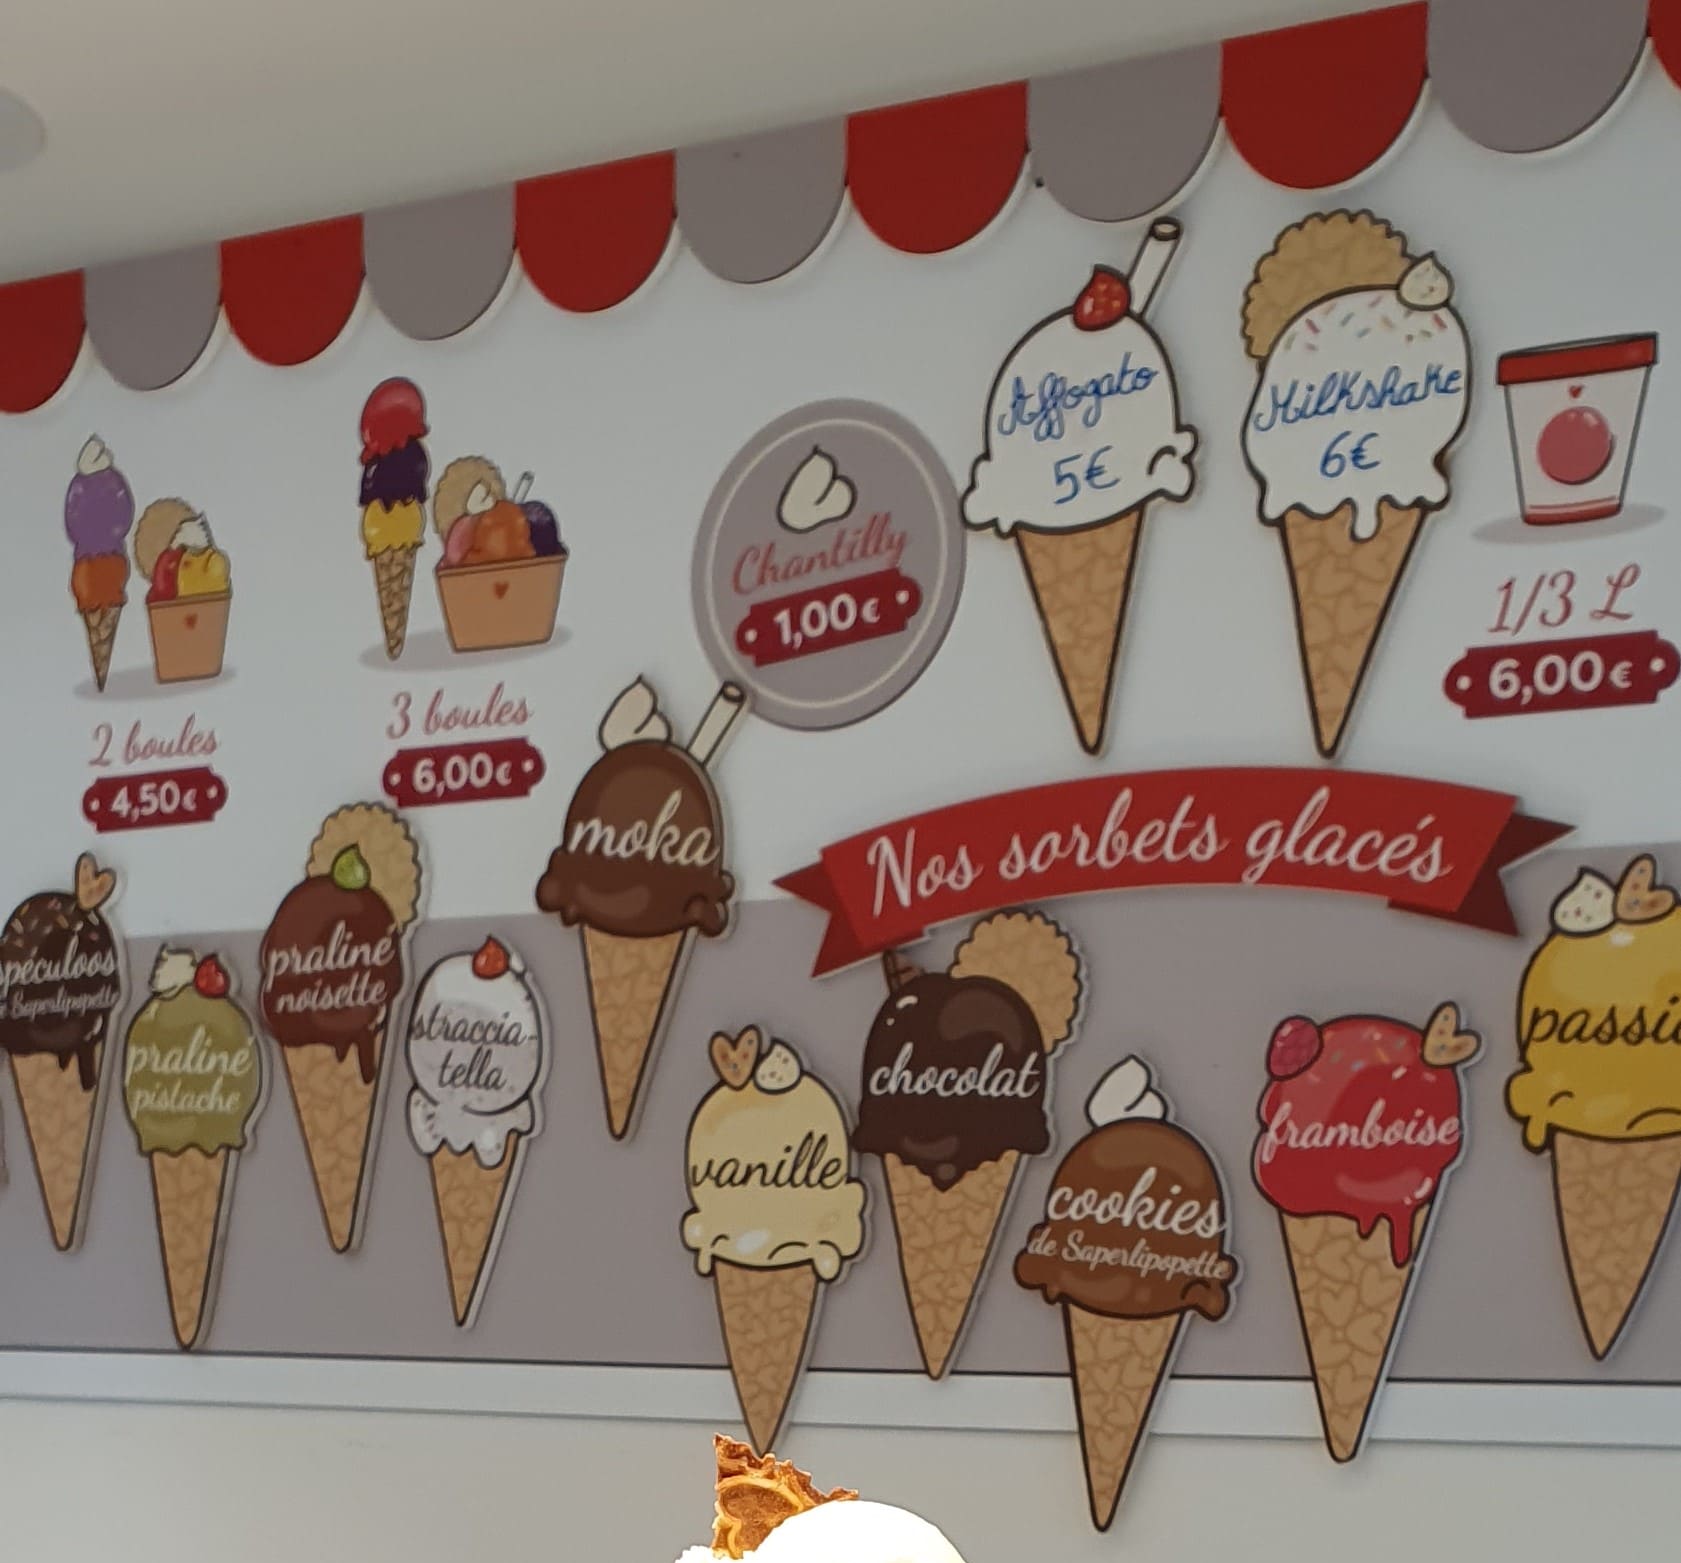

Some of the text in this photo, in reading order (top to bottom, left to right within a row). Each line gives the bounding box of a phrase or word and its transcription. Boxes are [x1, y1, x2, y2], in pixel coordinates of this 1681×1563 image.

[999, 352, 1159, 442] Affogato
[1053, 445, 1121, 504] 5€
[1319, 431, 1382, 478] 6€
[733, 511, 908, 595] Chantilly
[773, 593, 881, 649] 1,00€
[1488, 570, 1575, 635] 1/3
[1489, 650, 1633, 705] 6,00€
[387, 681, 533, 740] 3 boules
[88, 712, 218, 768] 2 boules
[110, 780, 197, 820] 4,50€
[413, 751, 513, 797] 6,00€
[567, 789, 720, 866] moka
[866, 786, 1454, 918] Nos sorbets glacés
[266, 920, 397, 978] praliné
[276, 977, 387, 1015] noisette
[128, 1030, 254, 1088] praliné
[437, 1046, 506, 1090] tella
[868, 1042, 1041, 1098] chocolat
[132, 1075, 241, 1113] pistache
[690, 1131, 848, 1189] vanille
[1262, 1100, 1459, 1163] framboise
[1048, 1166, 1226, 1239] cookies
[1027, 1227, 1232, 1281] de Saperlipopette
